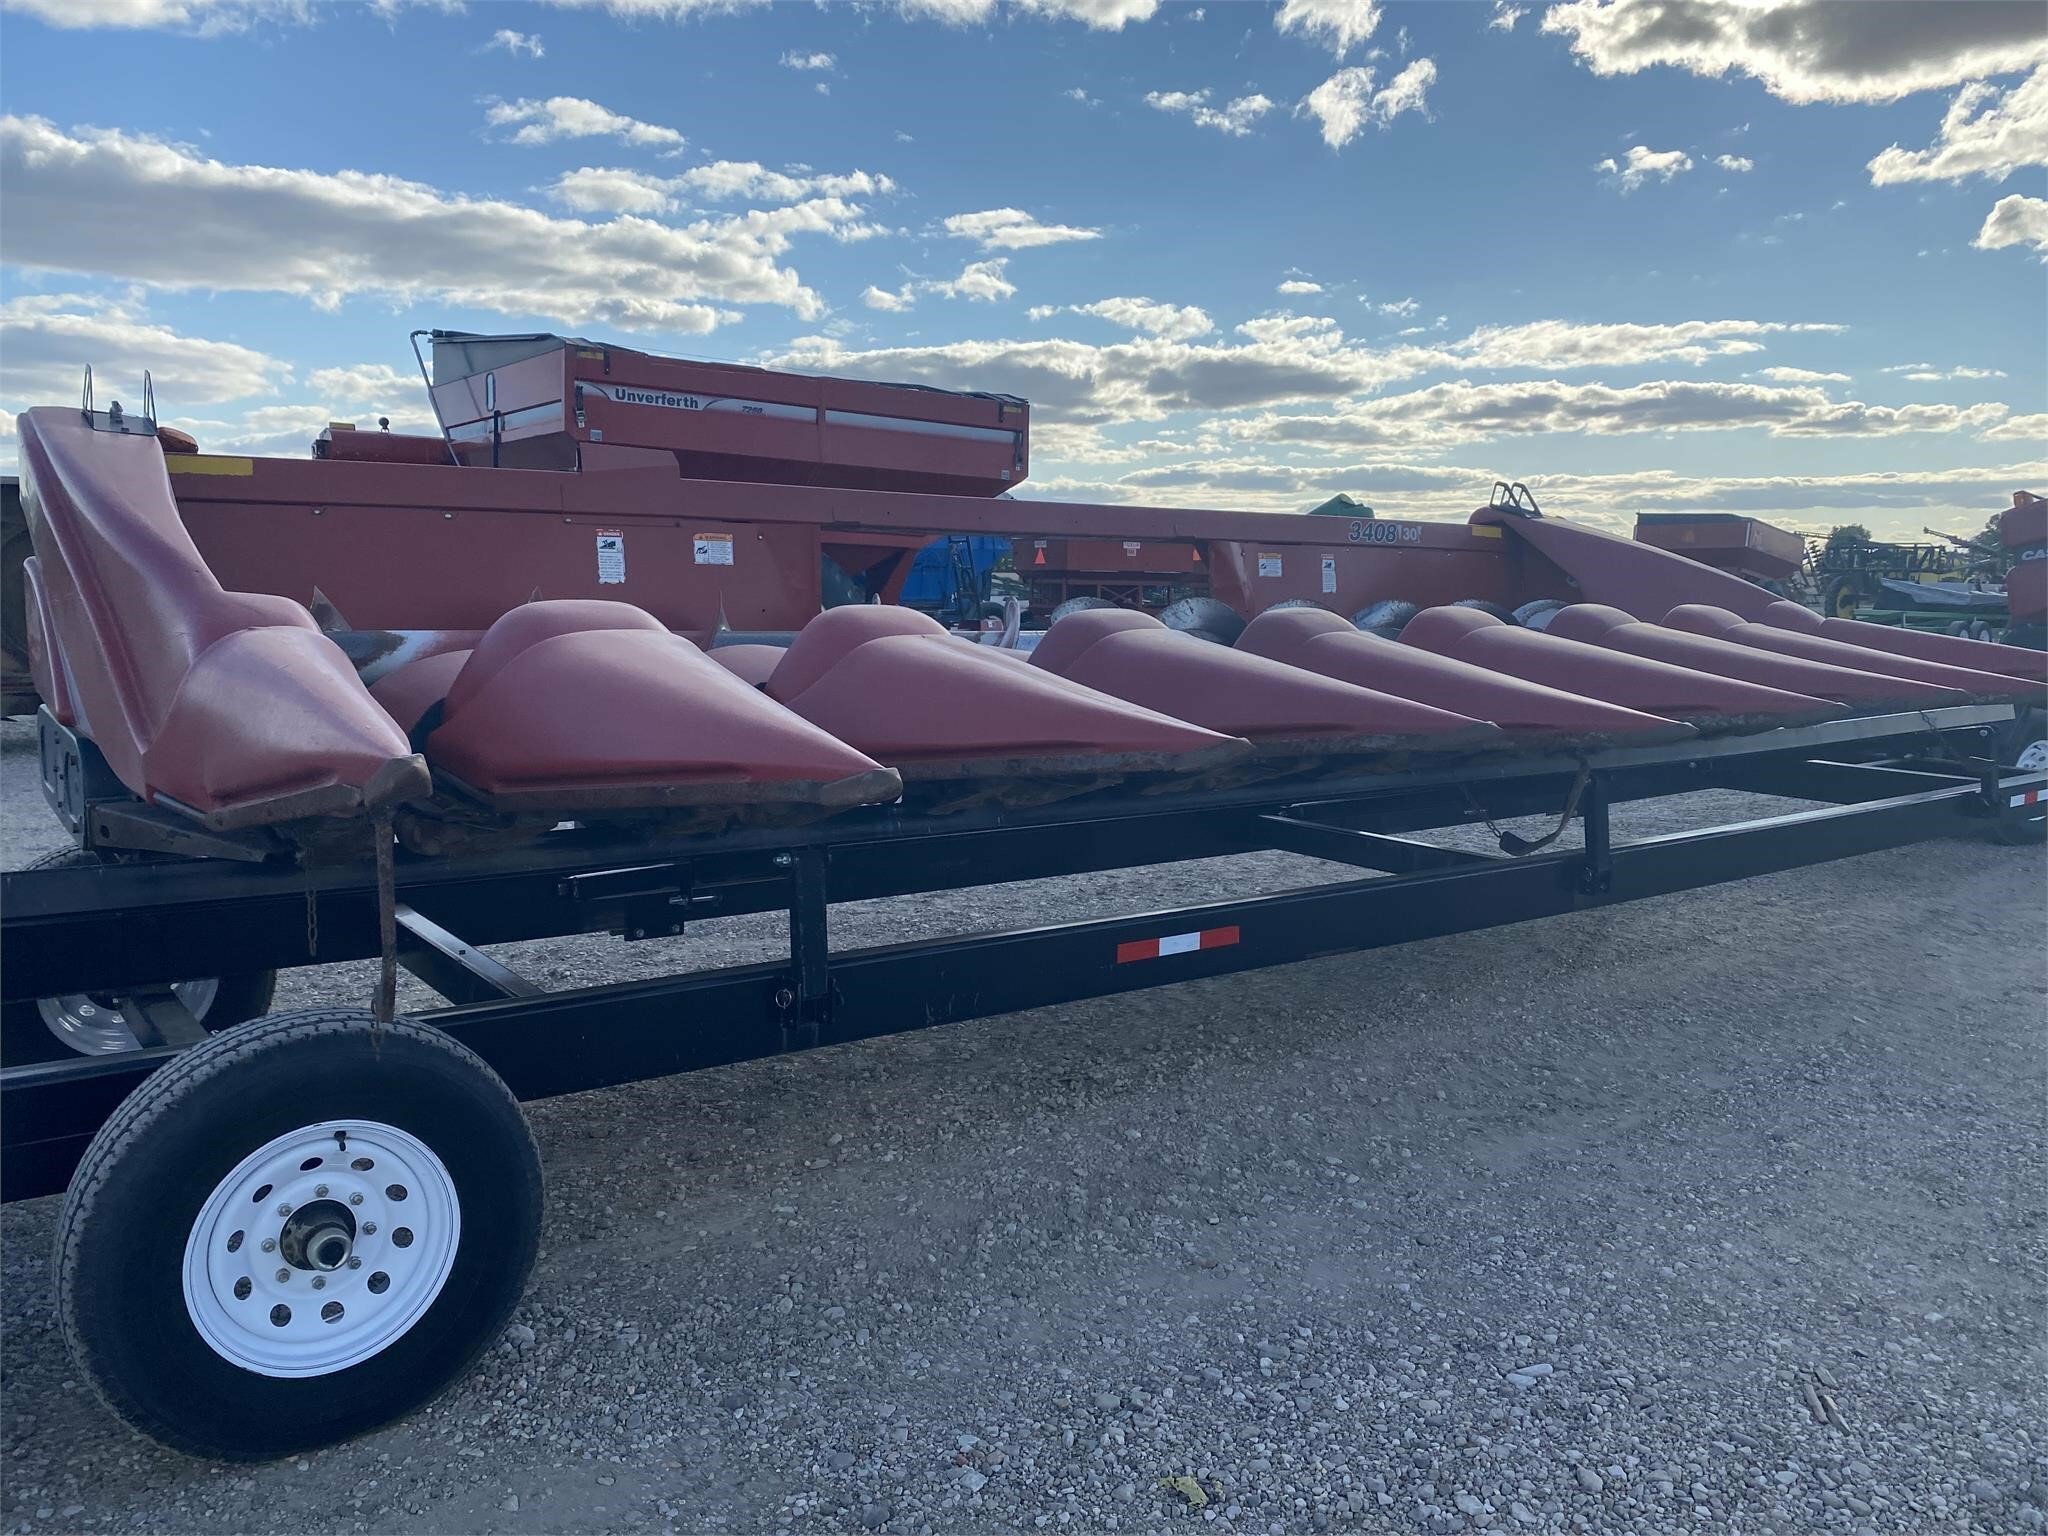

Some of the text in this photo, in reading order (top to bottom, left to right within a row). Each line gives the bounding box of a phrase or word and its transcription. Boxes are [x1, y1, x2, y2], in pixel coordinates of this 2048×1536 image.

[615, 388, 699, 408] Unverferth
[1348, 521, 1397, 543] 3408
[2022, 549, 2048, 561] CA
